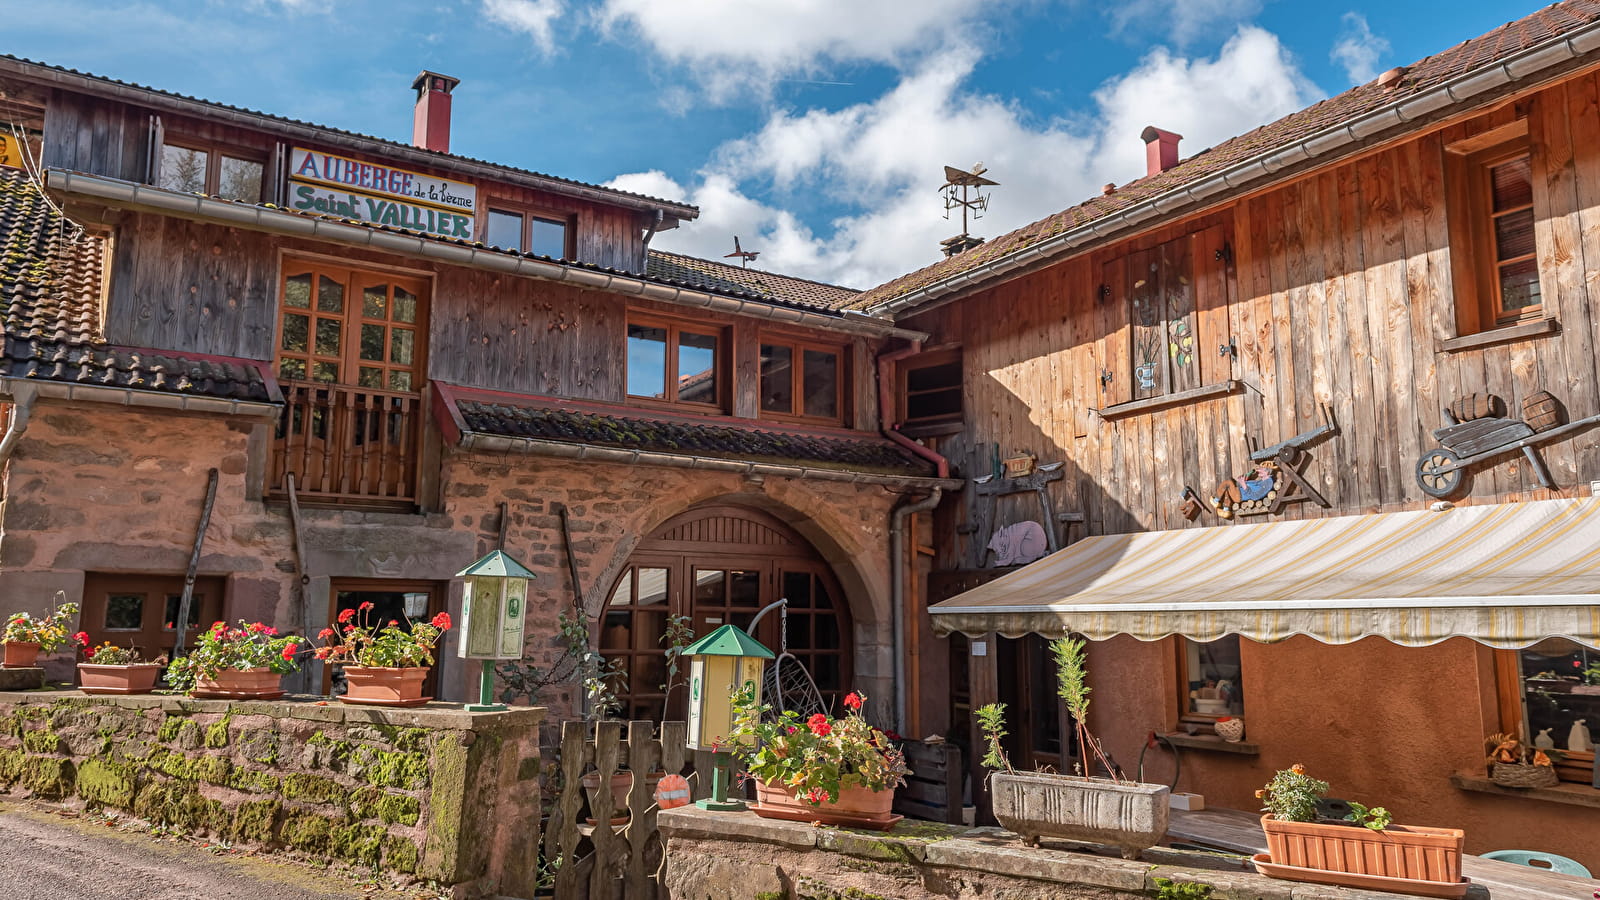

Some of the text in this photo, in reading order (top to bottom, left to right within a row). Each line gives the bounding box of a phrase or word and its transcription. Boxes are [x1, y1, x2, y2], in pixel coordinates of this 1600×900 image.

[297, 151, 413, 196] AUBERGE
[414, 183, 426, 198] de
[427, 184, 439, 201] la
[294, 186, 471, 239] Saint VALLIER
